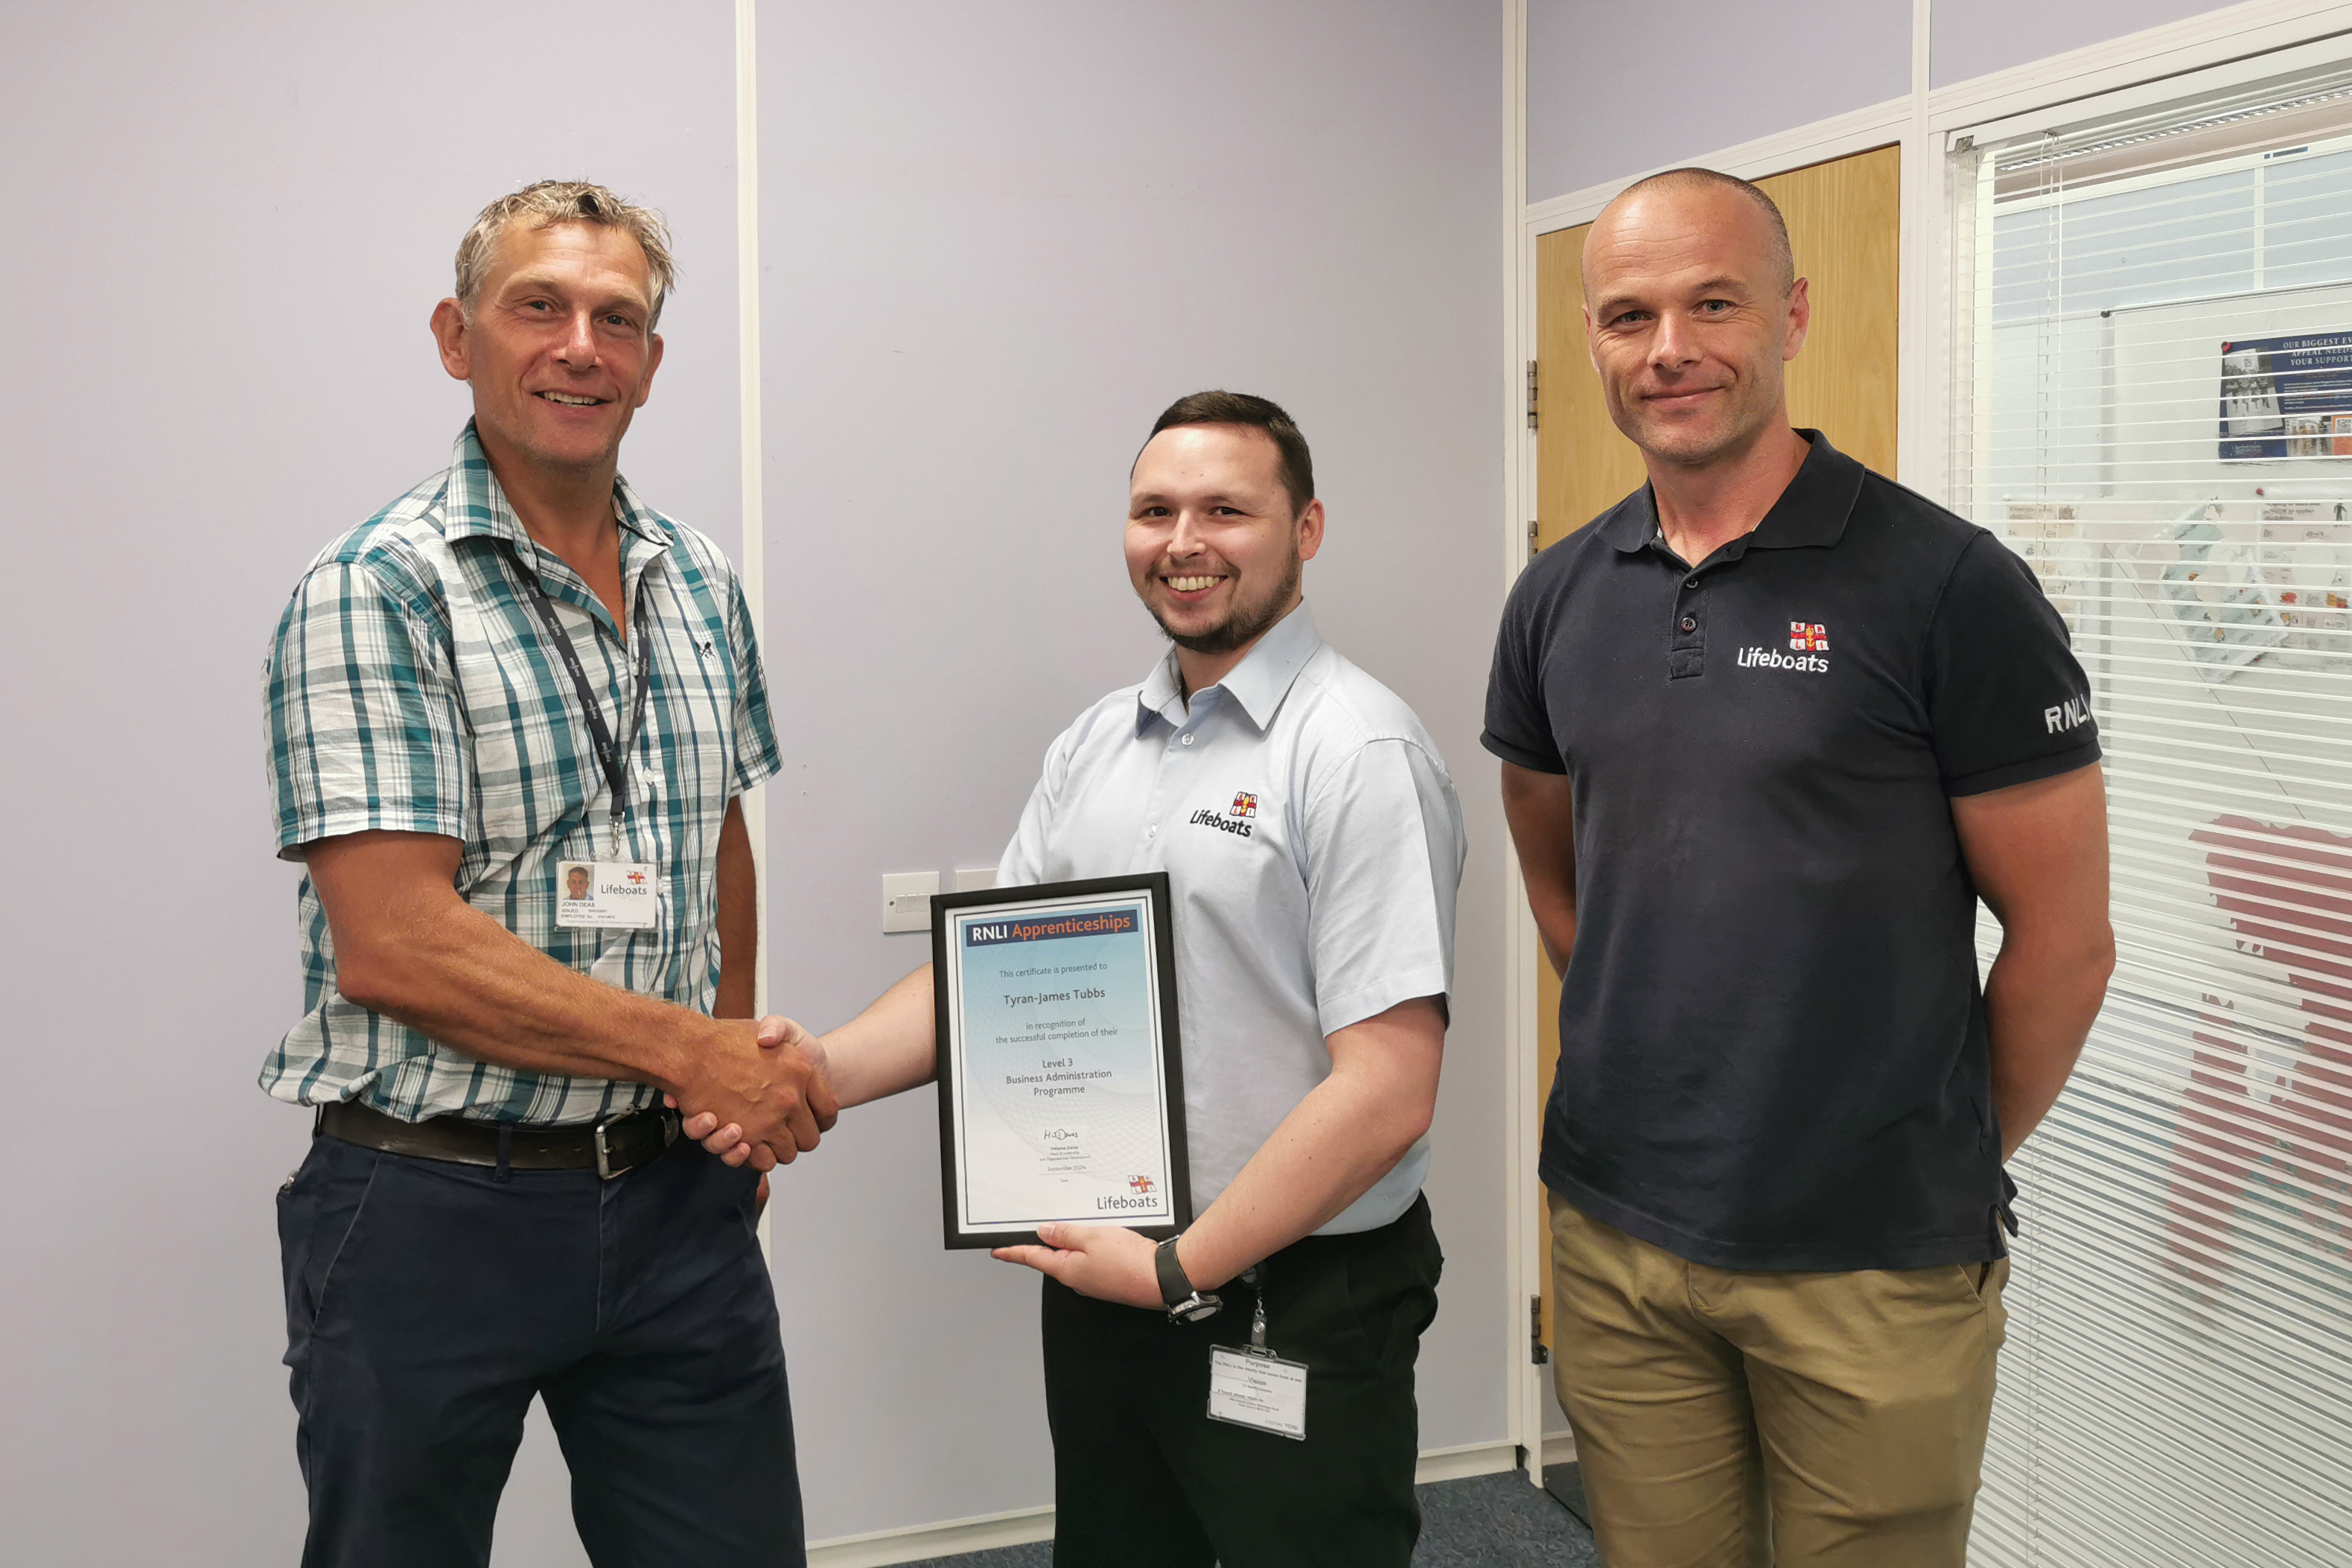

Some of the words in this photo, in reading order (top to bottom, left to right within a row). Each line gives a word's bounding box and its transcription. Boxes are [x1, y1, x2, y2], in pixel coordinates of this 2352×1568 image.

[2283, 340, 2299, 348] OUR
[2301, 337, 2339, 347] BIGGEST
[2290, 357, 2313, 366] YOUR
[1737, 646, 1829, 672] Lifeboats
[1190, 809, 1252, 838] Lifeboats
[601, 885, 647, 895] Lifeboats
[972, 924, 1007, 941] RNLI
[1012, 914, 1131, 940] Apprenticeships
[999, 970, 1014, 978] This
[1016, 967, 1051, 976] certificate
[1054, 965, 1059, 973] is
[1061, 963, 1097, 975] presented
[1004, 992, 1071, 1007] Tyran-James
[1073, 987, 1106, 999] Tubbs
[1035, 1019, 1076, 1030] recognition
[1077, 1018, 1086, 1026] of
[995, 1036, 1007, 1044] the
[1010, 1033, 1046, 1043] successful
[1048, 1030, 1089, 1041] completion
[1091, 1028, 1099, 1037] of
[1100, 1027, 1119, 1036] their
[1042, 1058, 1065, 1068] Level
[1068, 1058, 1074, 1066] 3
[1007, 1074, 1043, 1084] Business
[1045, 1069, 1112, 1082] Administration
[1033, 1086, 1086, 1097] Programme
[1097, 1195, 1158, 1210] Lifeboats
